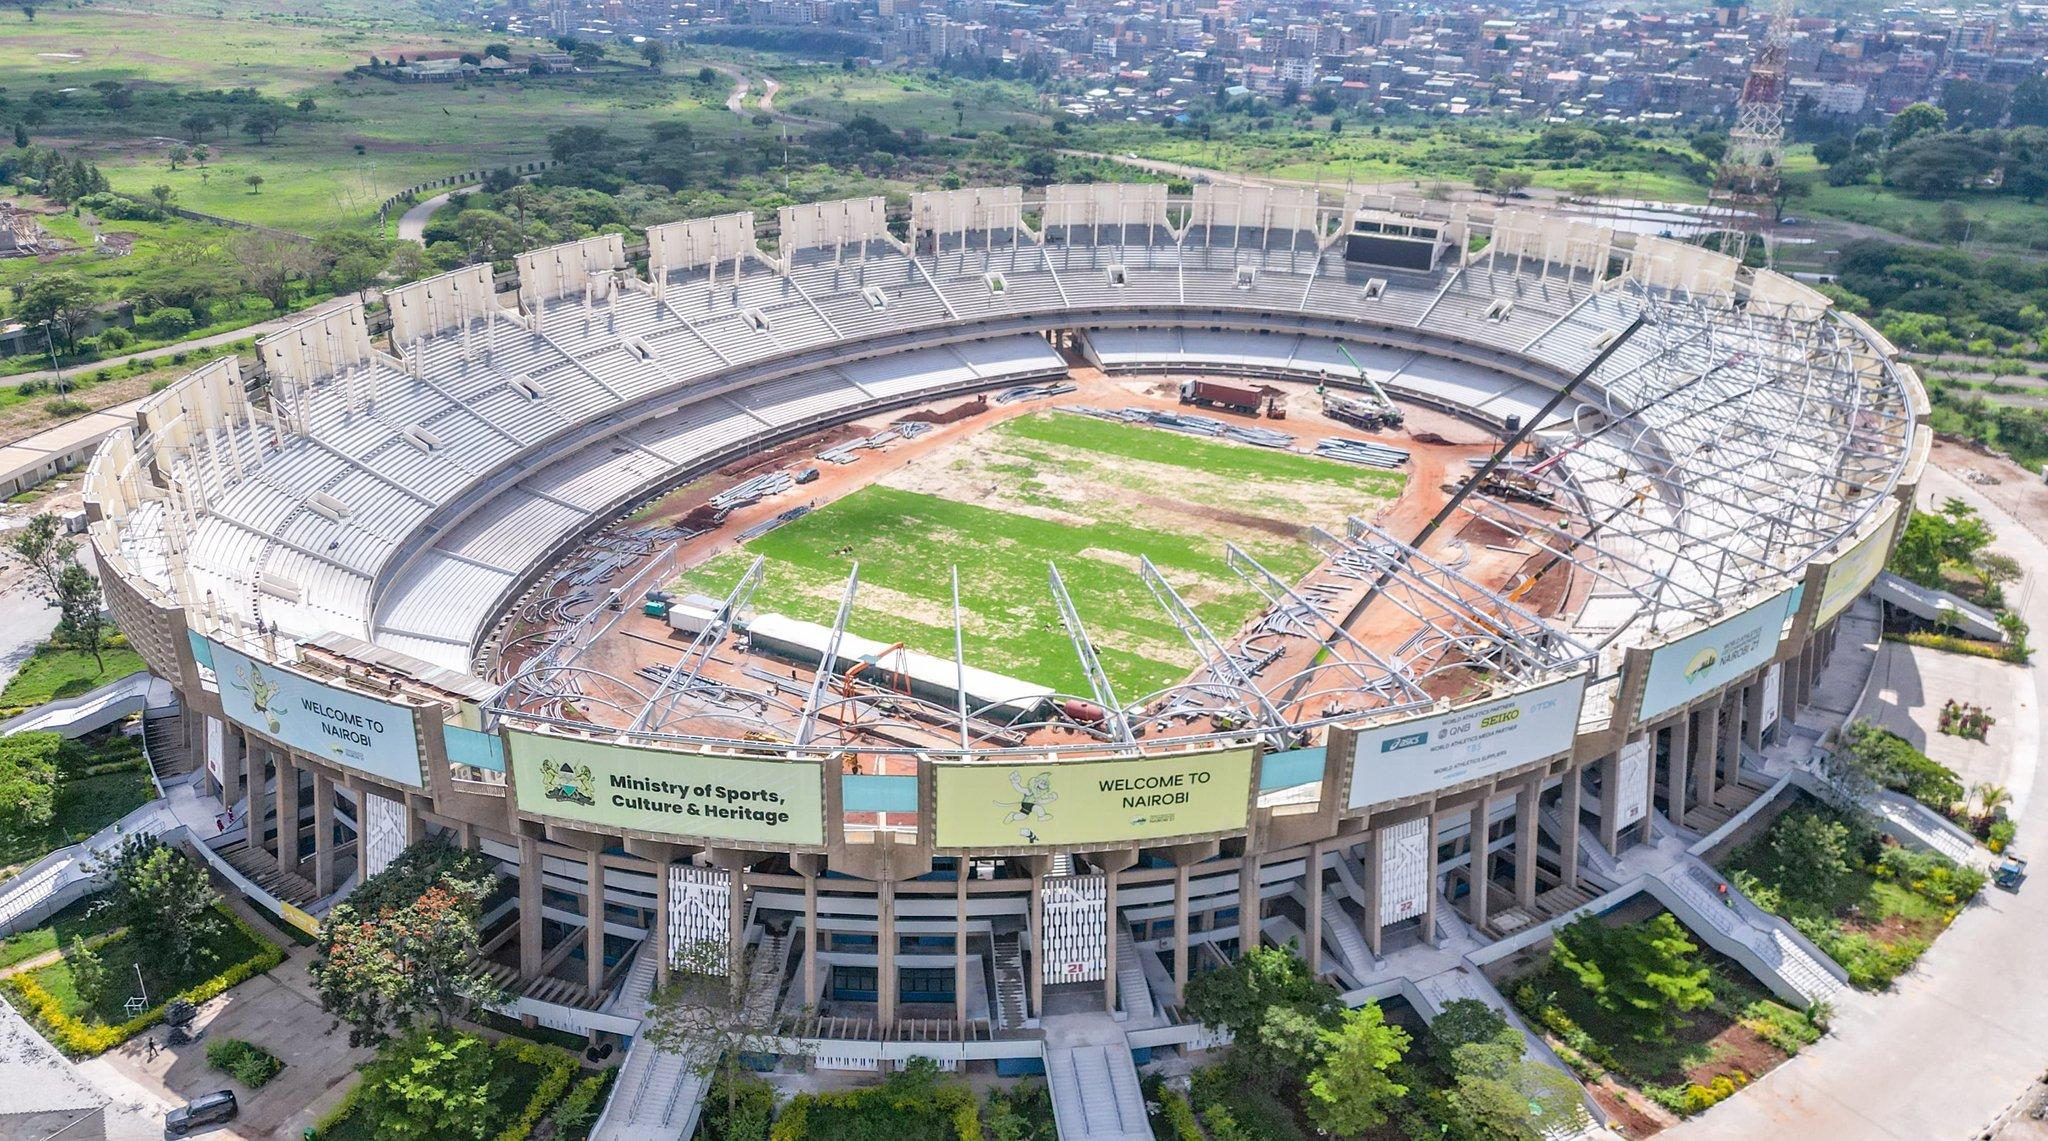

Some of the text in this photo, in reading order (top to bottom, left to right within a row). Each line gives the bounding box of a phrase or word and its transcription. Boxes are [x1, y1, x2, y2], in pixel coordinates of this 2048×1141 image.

[301, 697, 384, 734] WELCOME TO
[1442, 716, 1462, 726] WORLD
[1480, 709, 1520, 729] SEIKO
[321, 722, 372, 748] NAIROBI
[1449, 722, 1471, 736] QNB
[1430, 742, 1450, 753] WORLD
[609, 774, 786, 806] Ministry of Sports,
[1099, 771, 1211, 792] WELCOME TO
[611, 794, 790, 826] Culture & Heritage
[1122, 792, 1189, 808] NAIROBI
[1067, 963, 1084, 973] 21
